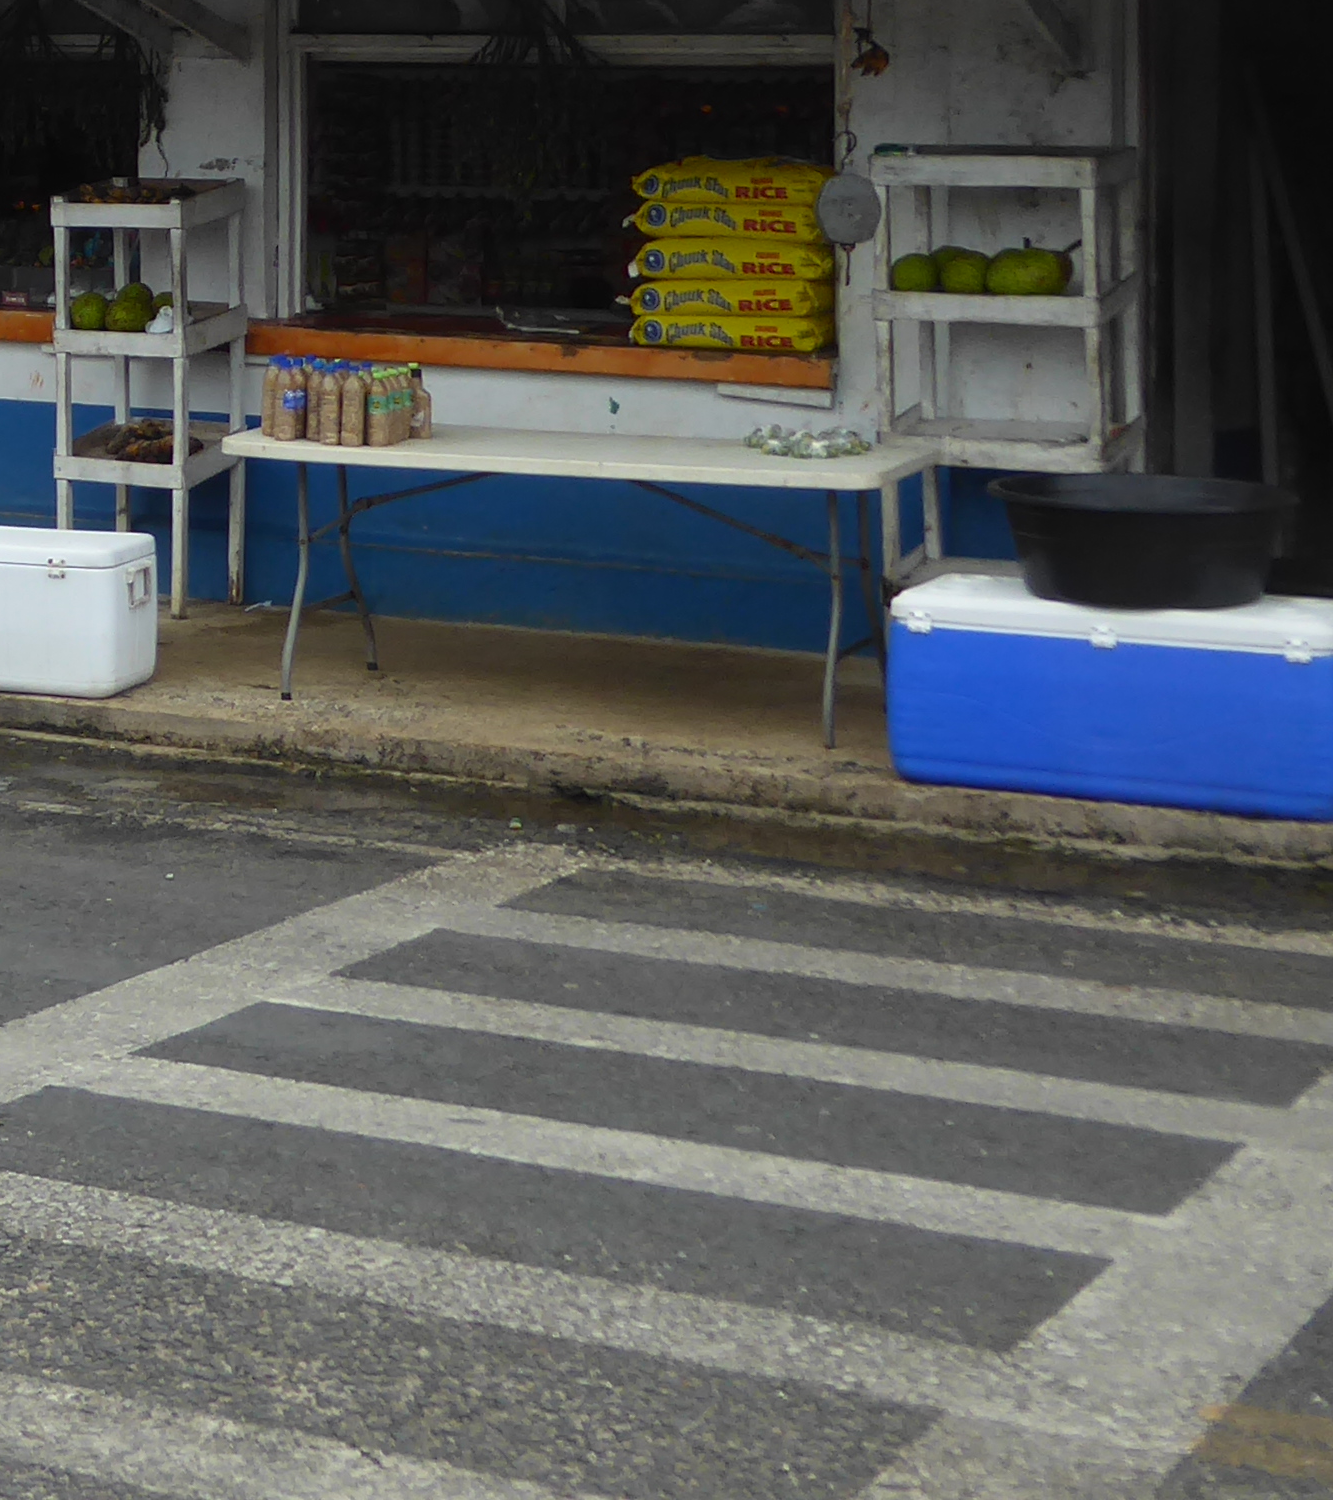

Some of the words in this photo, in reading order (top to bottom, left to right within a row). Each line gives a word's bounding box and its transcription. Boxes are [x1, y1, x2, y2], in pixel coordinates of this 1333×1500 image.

[662, 176, 701, 199] Chuuk
[735, 186, 789, 199] RICE
[670, 206, 711, 228] Chuuk
[743, 219, 797, 234] RICE
[669, 249, 708, 273] Chuuk
[742, 261, 795, 275] RICE
[665, 289, 705, 312] Chuuk
[738, 298, 793, 312] RICE
[667, 322, 706, 344] Chuuk
[740, 334, 795, 348] RICE
